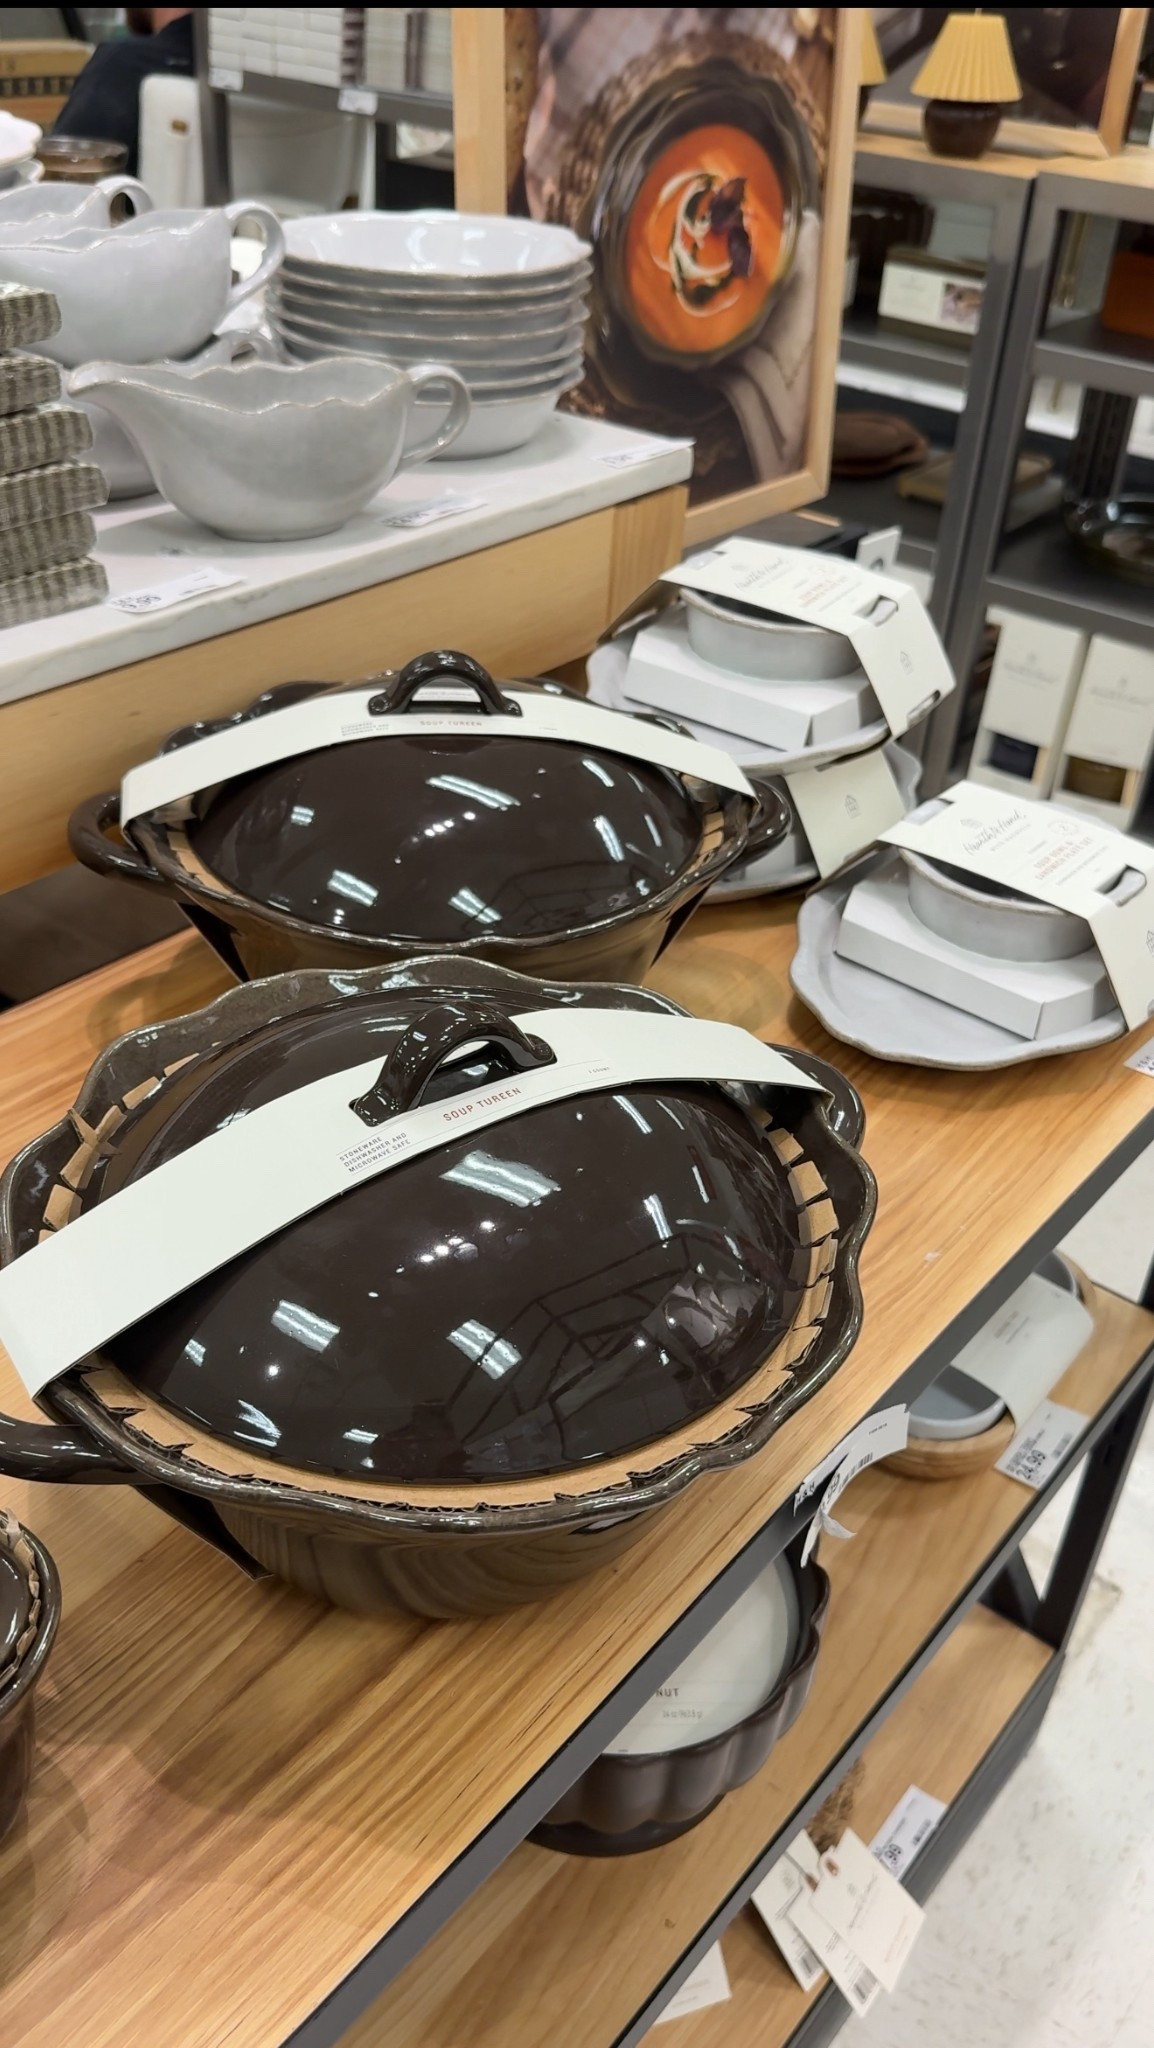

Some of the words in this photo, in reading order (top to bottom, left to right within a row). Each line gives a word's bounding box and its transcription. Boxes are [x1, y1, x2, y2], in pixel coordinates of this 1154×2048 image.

[443, 1104, 474, 1122] SOUP
[476, 1087, 522, 1109] TUREEN
[339, 1136, 382, 1162] STONEWARE
[343, 1139, 391, 1167] DISHWASHER
[391, 1132, 407, 1146] AND
[348, 1145, 391, 1173] MICROWAVE
[392, 1139, 412, 1153] SAFE
[655, 1687, 679, 1698] NUT
